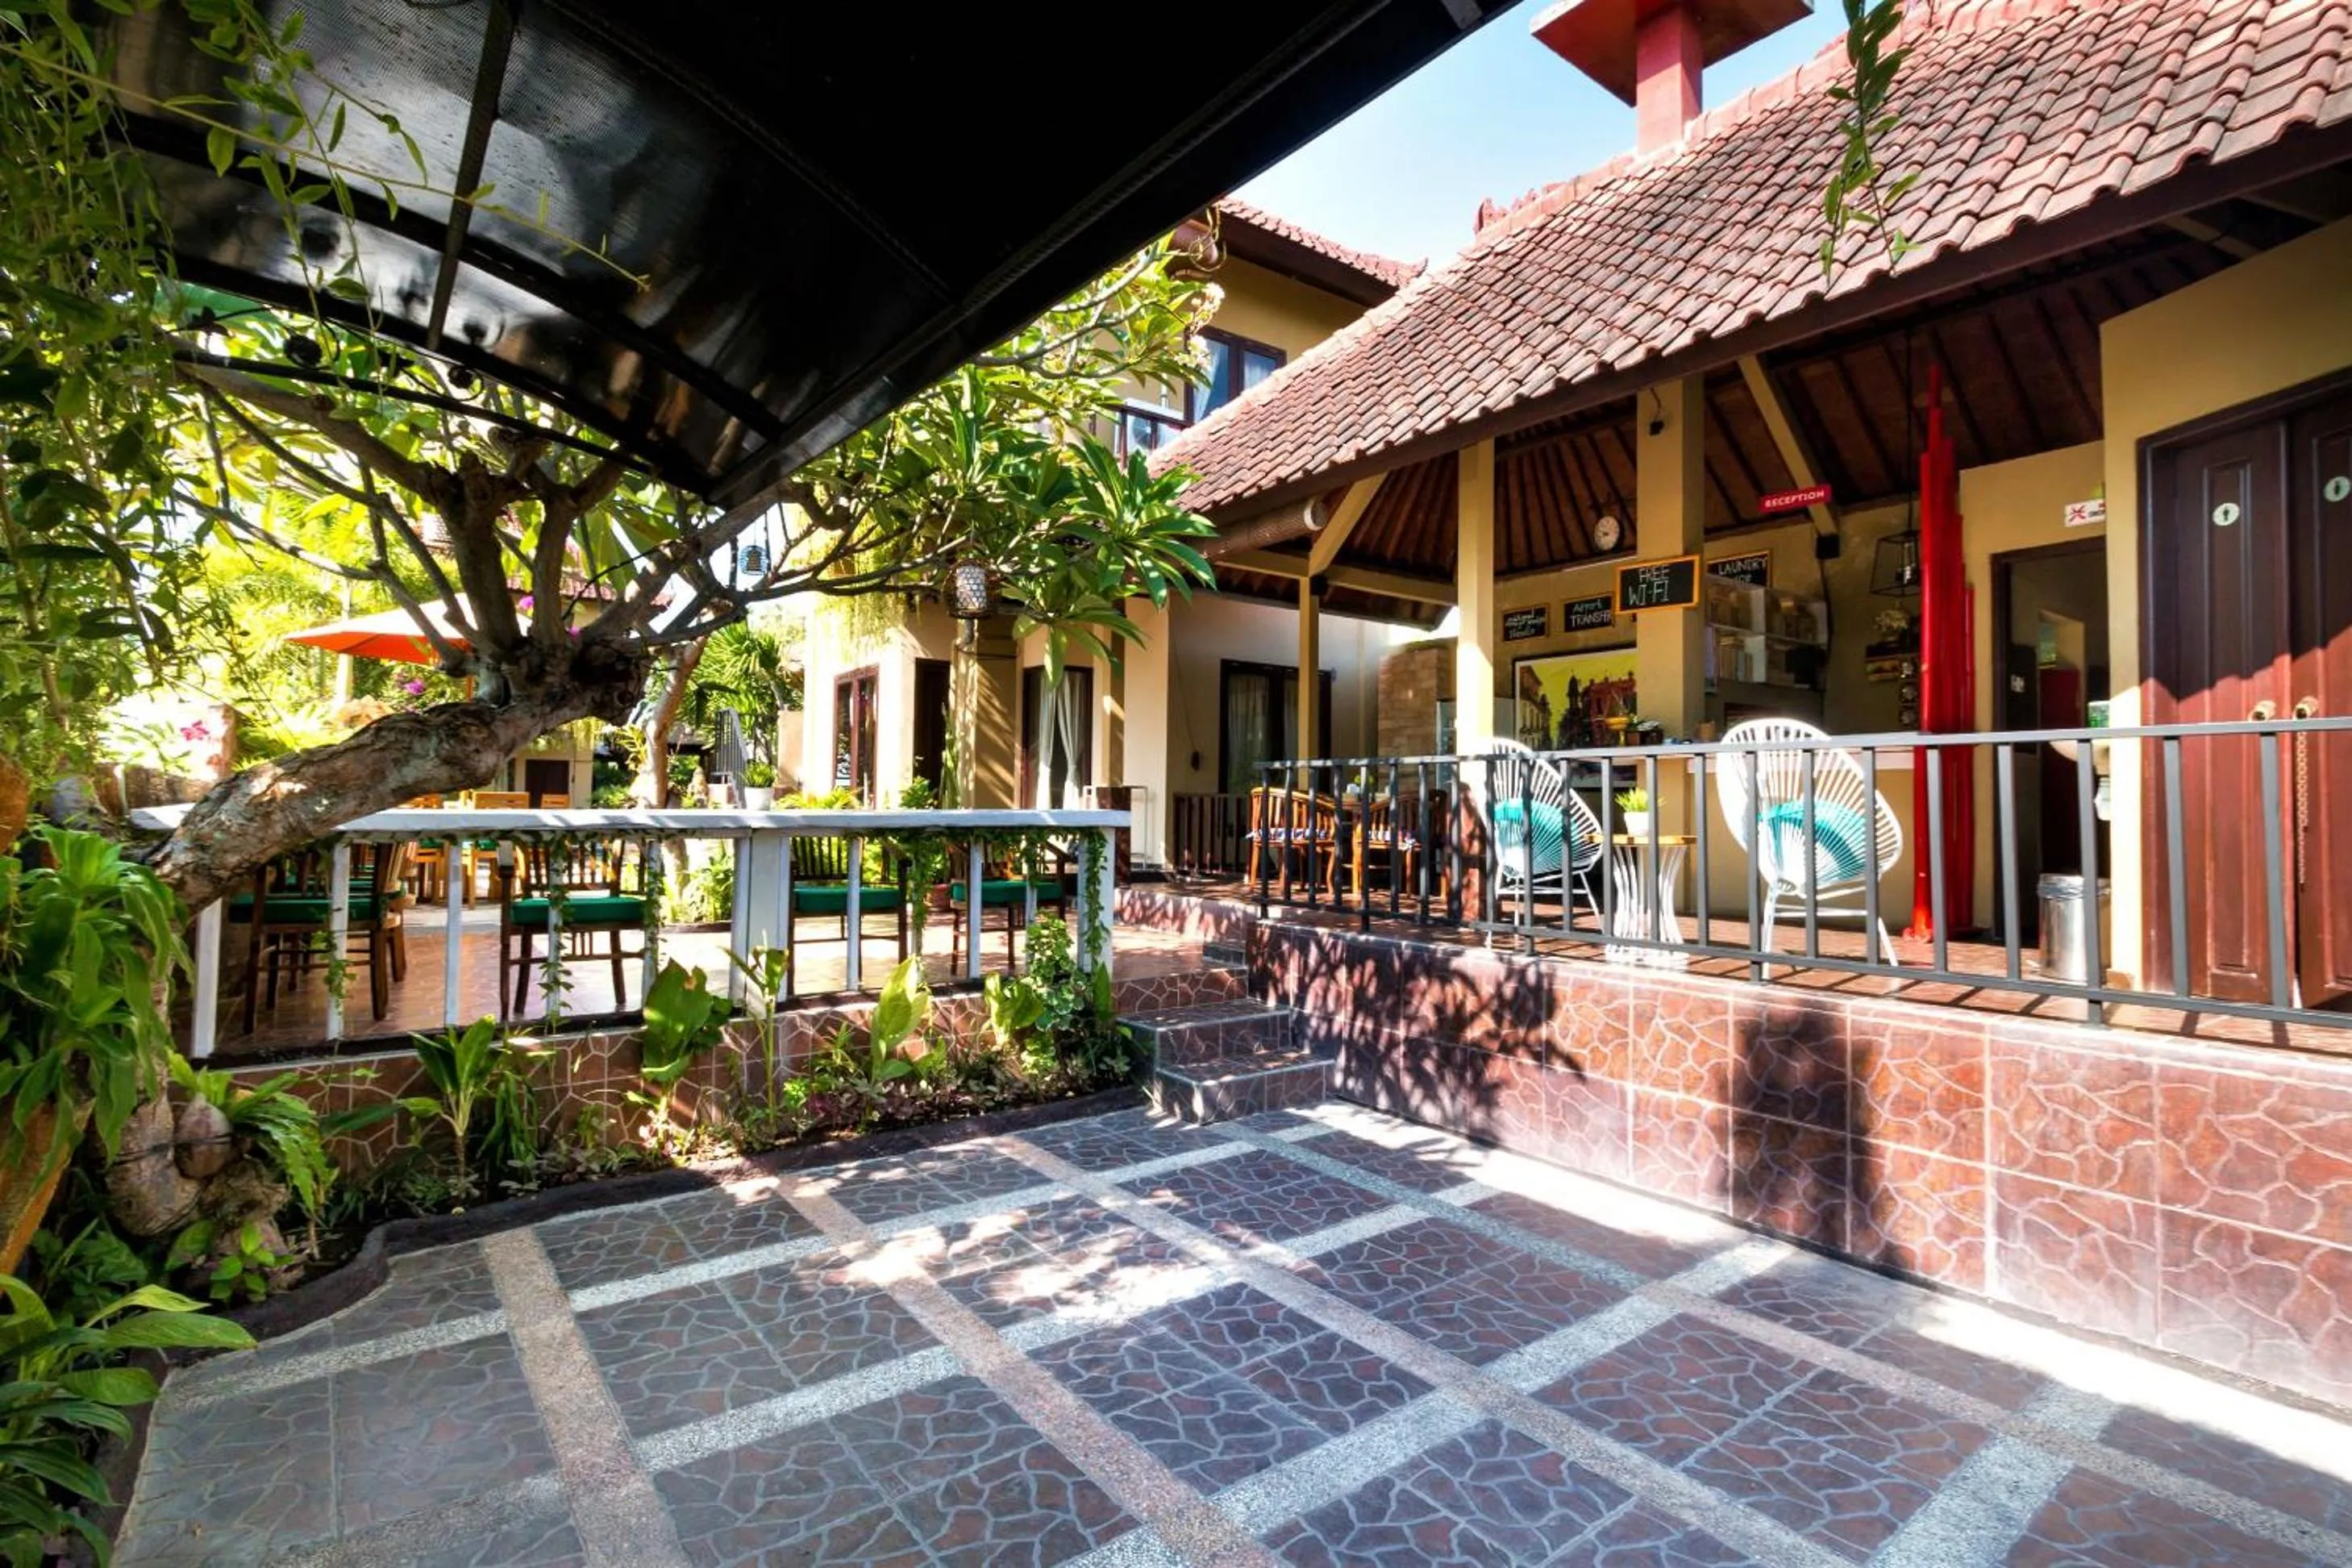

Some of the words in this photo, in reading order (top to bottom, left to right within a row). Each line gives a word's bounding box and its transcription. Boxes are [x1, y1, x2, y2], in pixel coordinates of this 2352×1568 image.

[1764, 489, 1825, 508] RECEPTION
[1638, 564, 1671, 583] FREE
[1717, 557, 1767, 576] LAUNDRY
[1629, 580, 1669, 605] WI-FI
